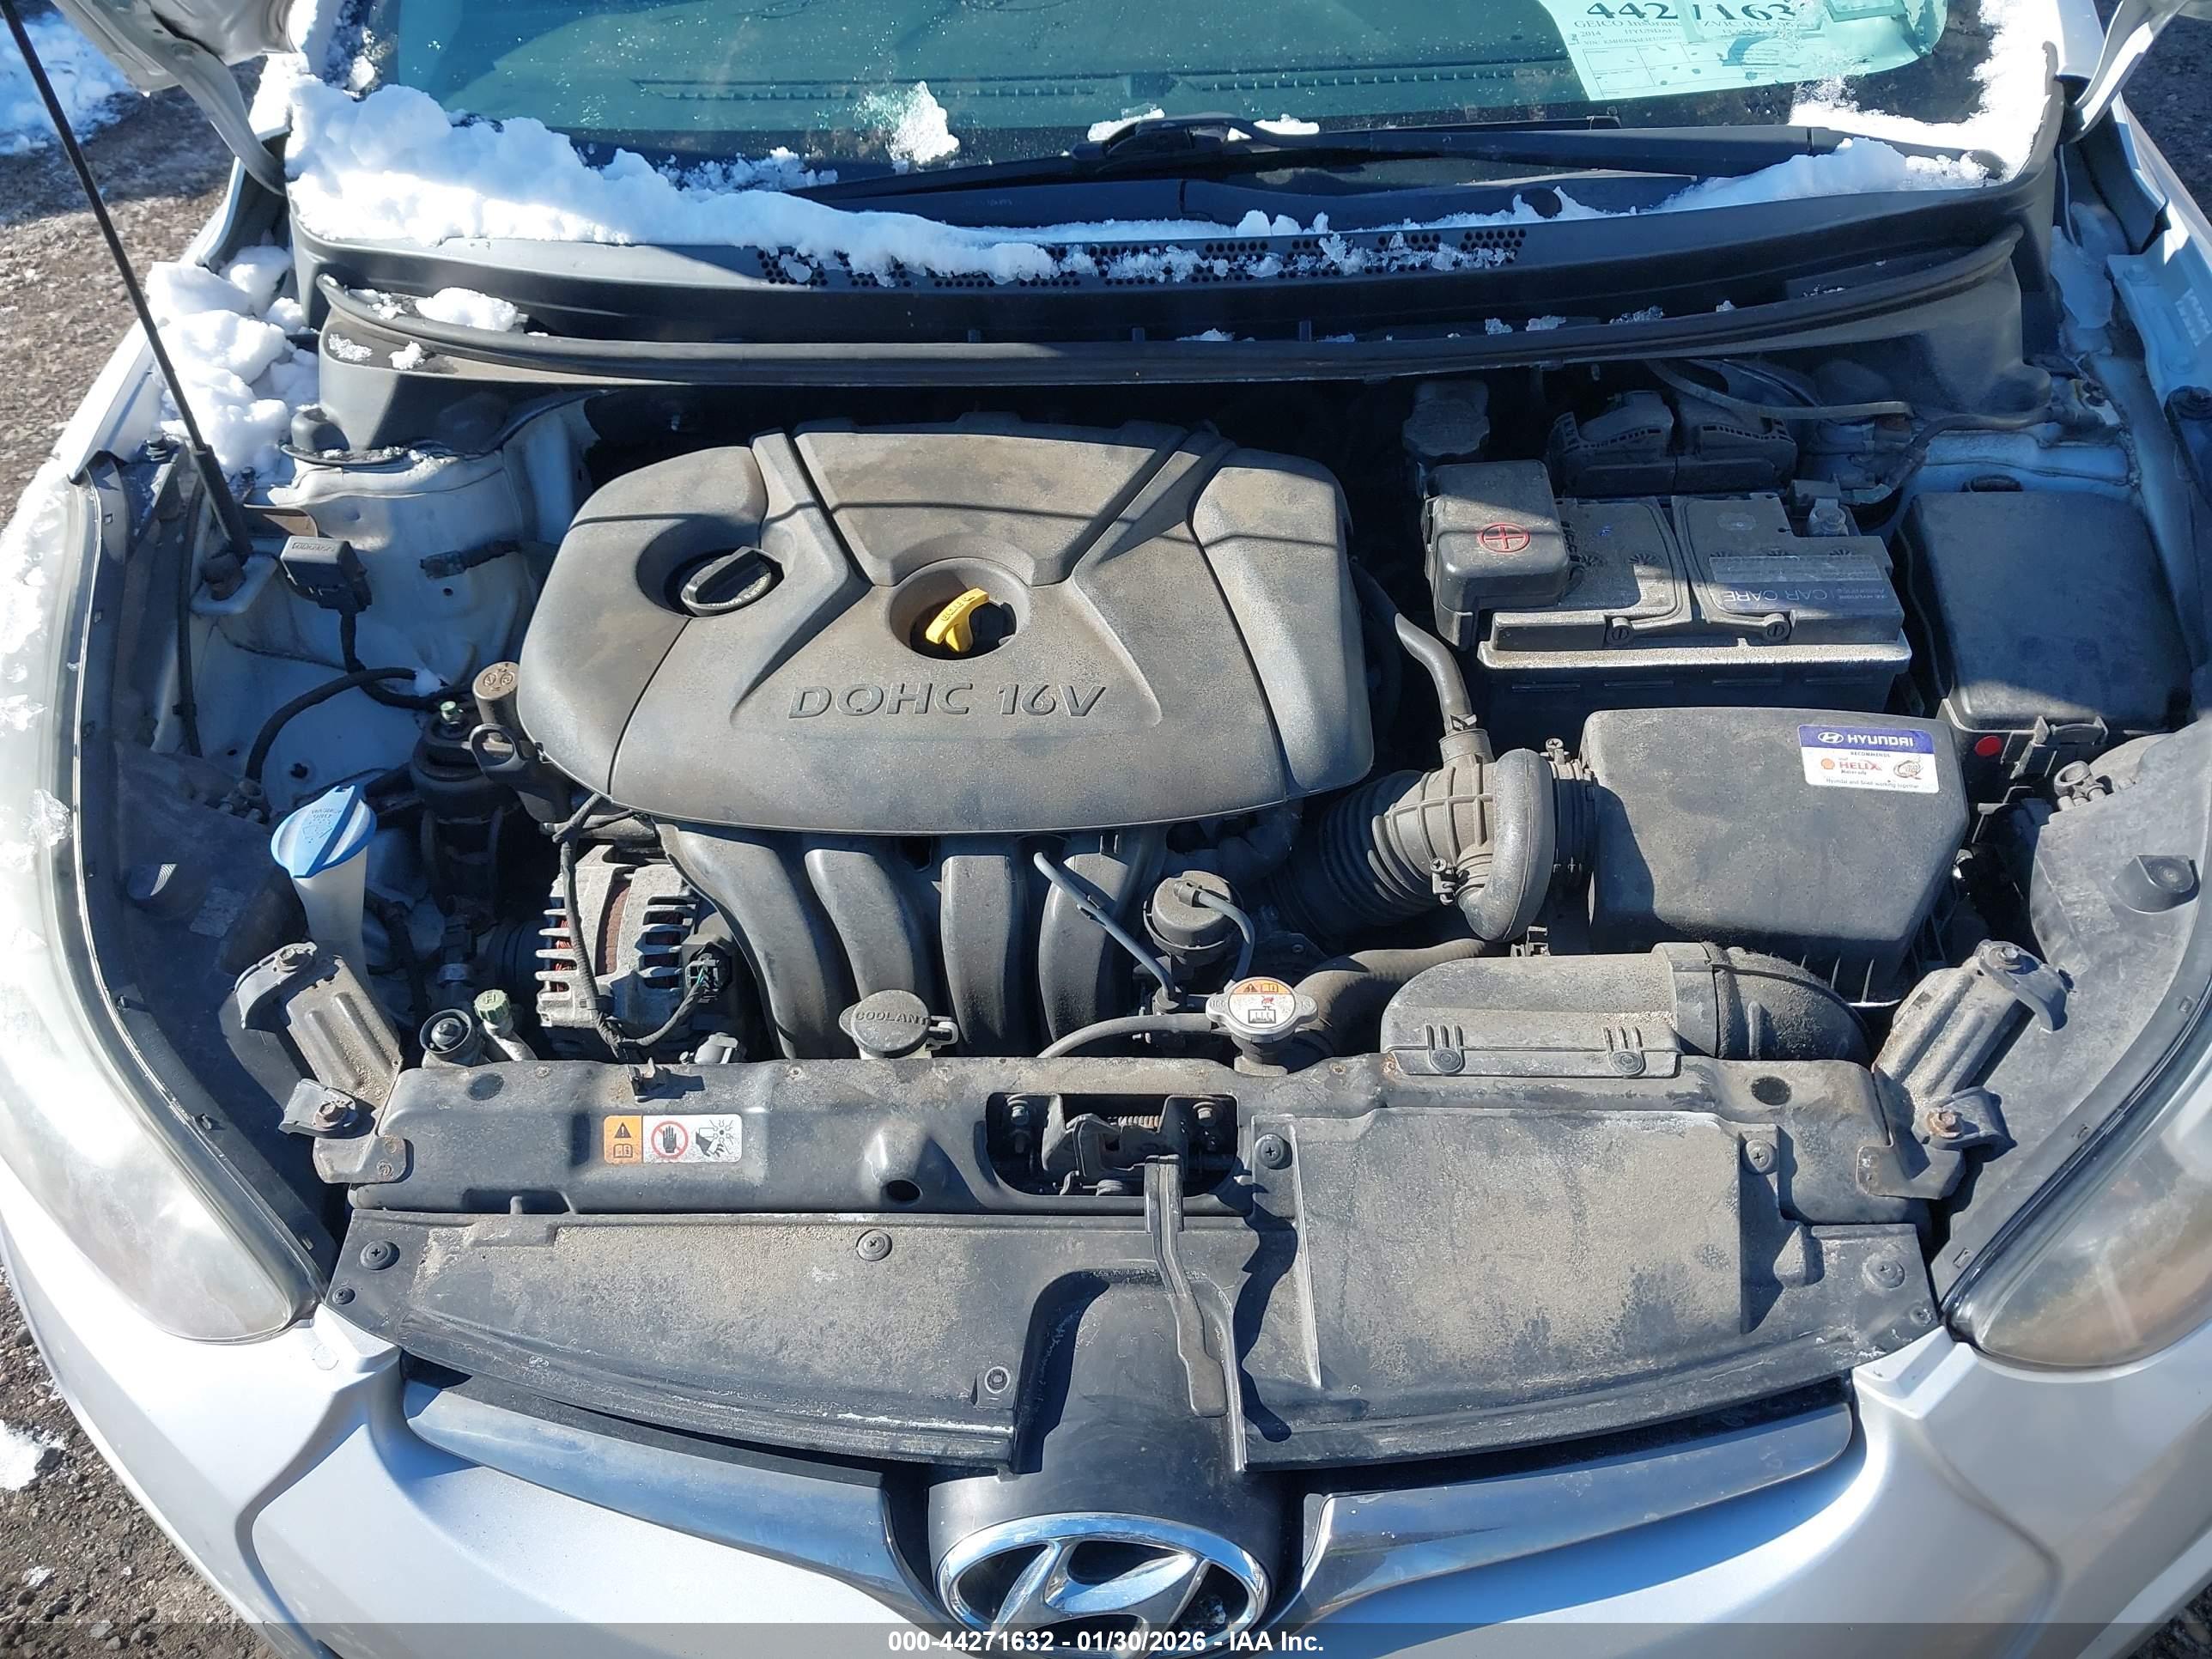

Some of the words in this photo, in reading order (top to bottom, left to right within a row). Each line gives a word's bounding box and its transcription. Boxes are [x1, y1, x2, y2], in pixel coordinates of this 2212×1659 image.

[1574, 20, 1624, 28] GEICO
[1626, 19, 1683, 27] Insuranc
[1724, 590, 1778, 602] CARE
[1784, 589, 1828, 601] CAR
[788, 683, 974, 720] DOHC
[998, 684, 1107, 717] 16V
[1847, 733, 1914, 747] HYUNDAI
[1839, 760, 1882, 771] HELIX
[855, 1011, 930, 1026] COOLANT
